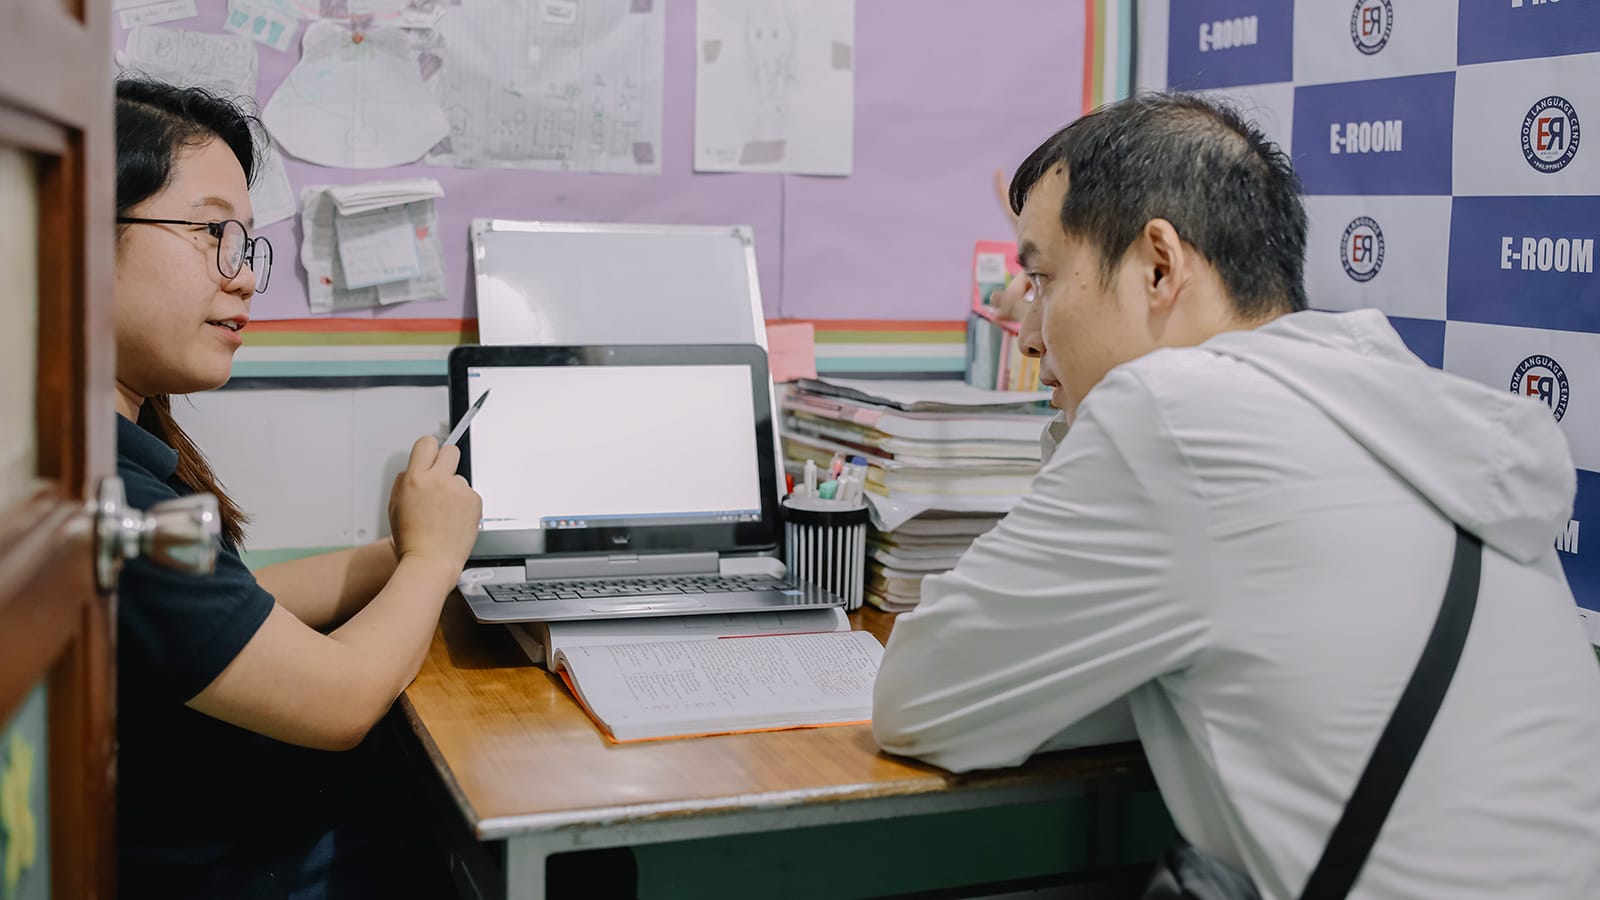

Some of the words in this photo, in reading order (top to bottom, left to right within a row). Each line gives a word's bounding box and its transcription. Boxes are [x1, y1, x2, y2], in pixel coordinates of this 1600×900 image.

[1199, 16, 1258, 52] E-ROOM
[1330, 120, 1402, 154] E-ROOM
[1522, 118, 1534, 160] E-ROOM
[1530, 98, 1574, 117] LANGUAGE
[1566, 118, 1580, 158] CENTER
[1501, 236, 1594, 273] E-ROOM
[1520, 357, 1563, 378] LANGUAGE
